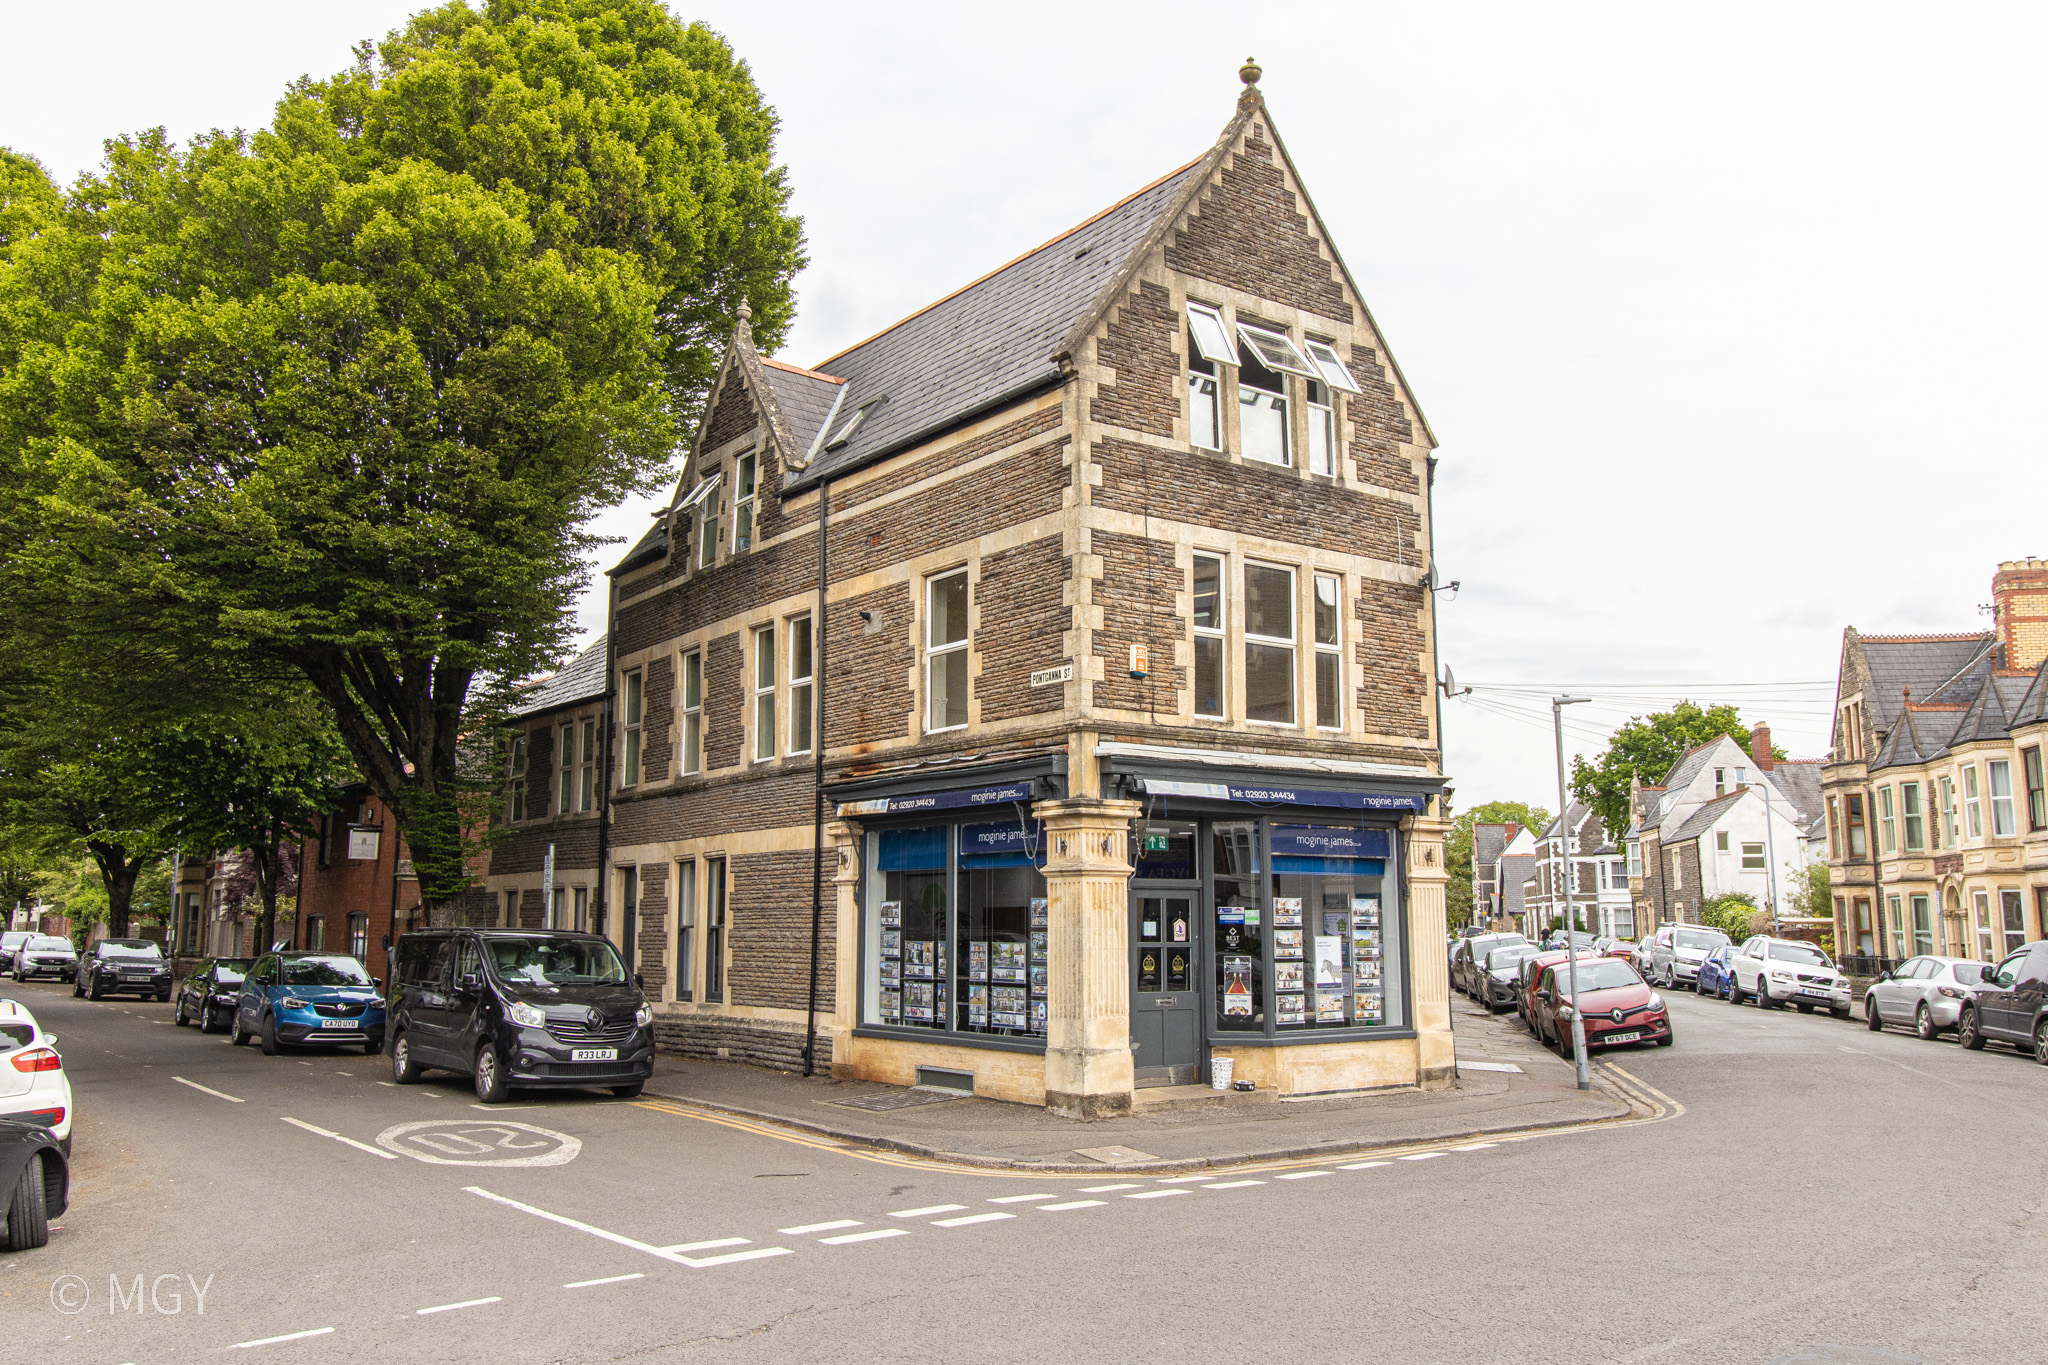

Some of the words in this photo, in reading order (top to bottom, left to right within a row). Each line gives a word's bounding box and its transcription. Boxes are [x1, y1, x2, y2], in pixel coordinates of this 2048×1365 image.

[1032, 669, 1062, 684] PONTCANNA
[971, 789, 997, 804] moginie
[1230, 789, 1244, 798] Tel:
[1245, 790, 1268, 799] 02920
[1269, 791, 1295, 801] 344434
[898, 800, 915, 809] 02920
[915, 798, 936, 807] 344434
[978, 829, 1006, 845] moginie
[1296, 834, 1329, 848] moginie
[578, 1051, 595, 1060] R33
[595, 1050, 612, 1059] LRJ
